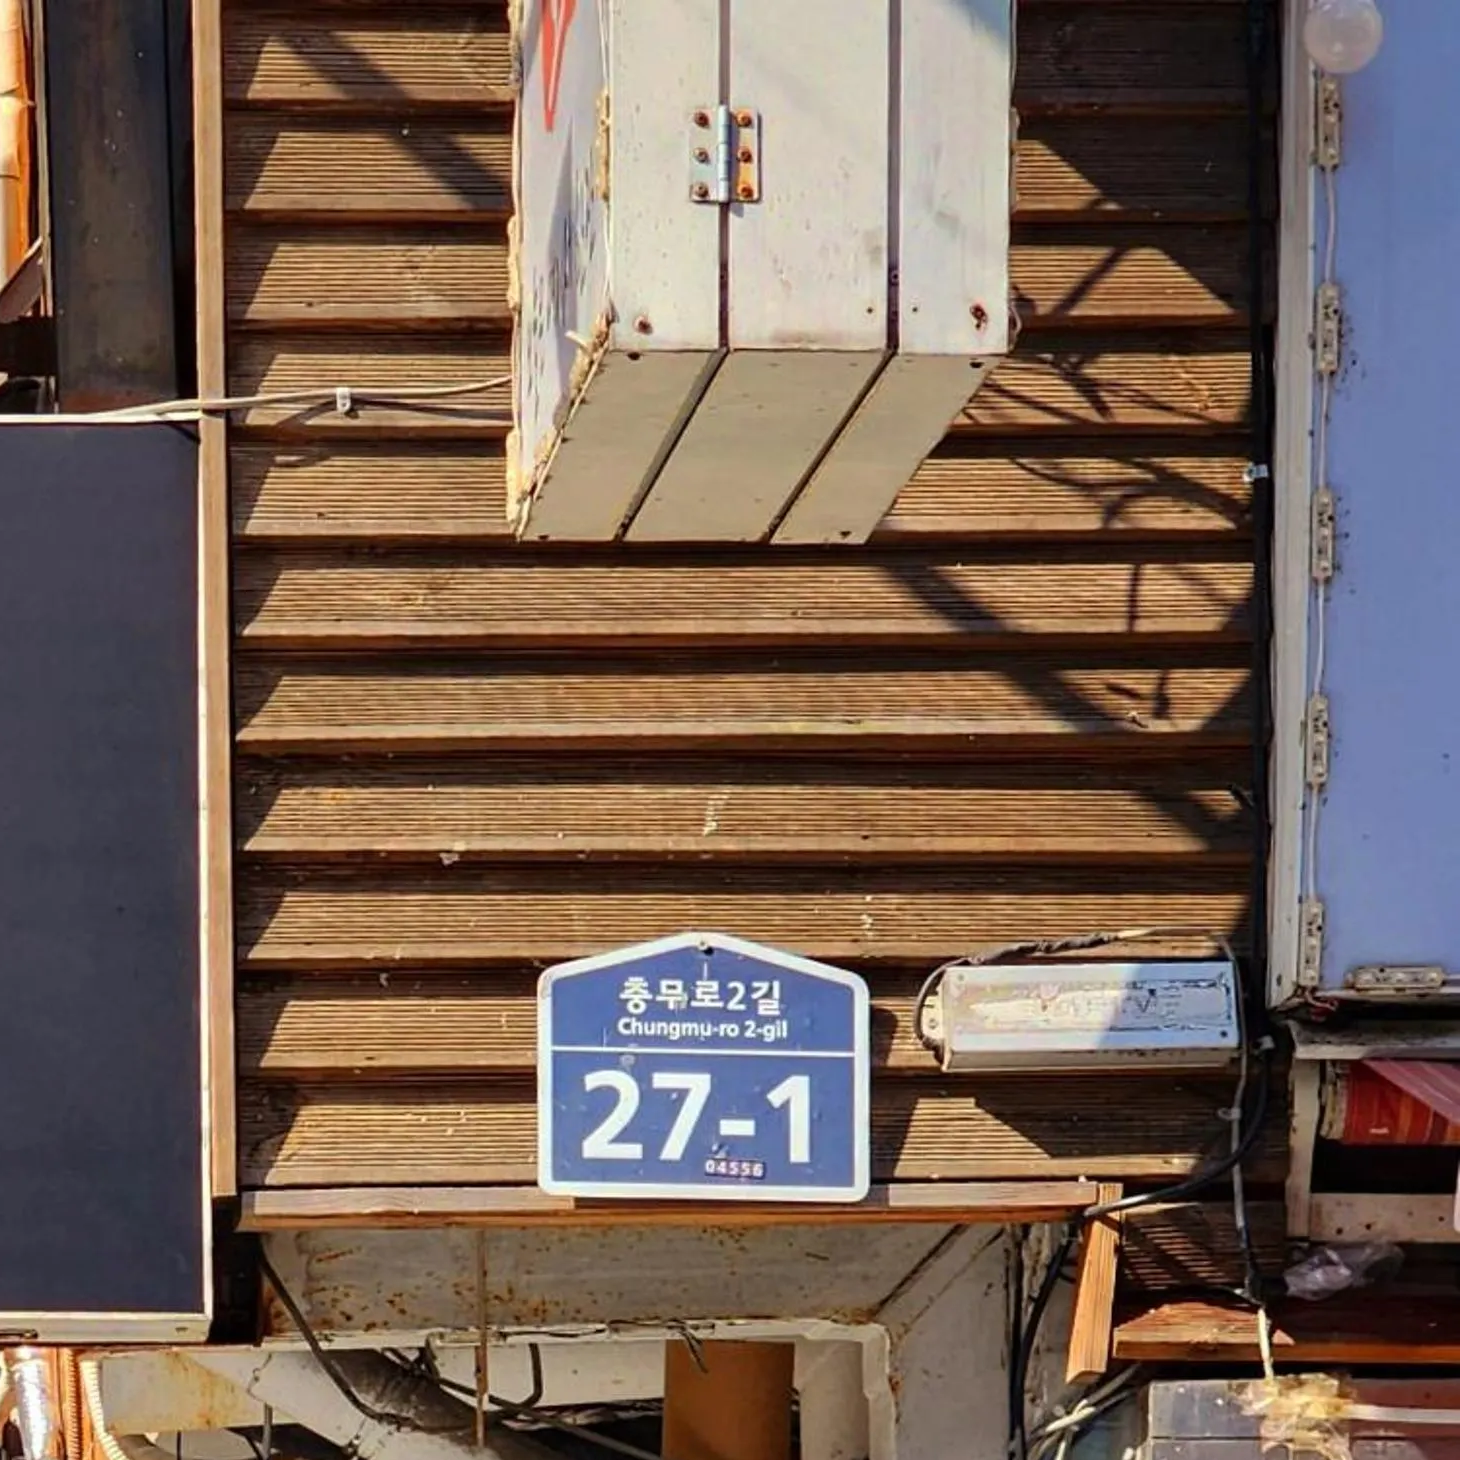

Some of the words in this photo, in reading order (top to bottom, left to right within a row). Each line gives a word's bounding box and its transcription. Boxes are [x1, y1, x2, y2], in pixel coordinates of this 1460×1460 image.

[618, 976, 783, 1016] 충무로2길
[617, 1017, 740, 1041] Chungmu-ro
[744, 1020, 788, 1043] 2-gil
[582, 1069, 810, 1164] 27-1
